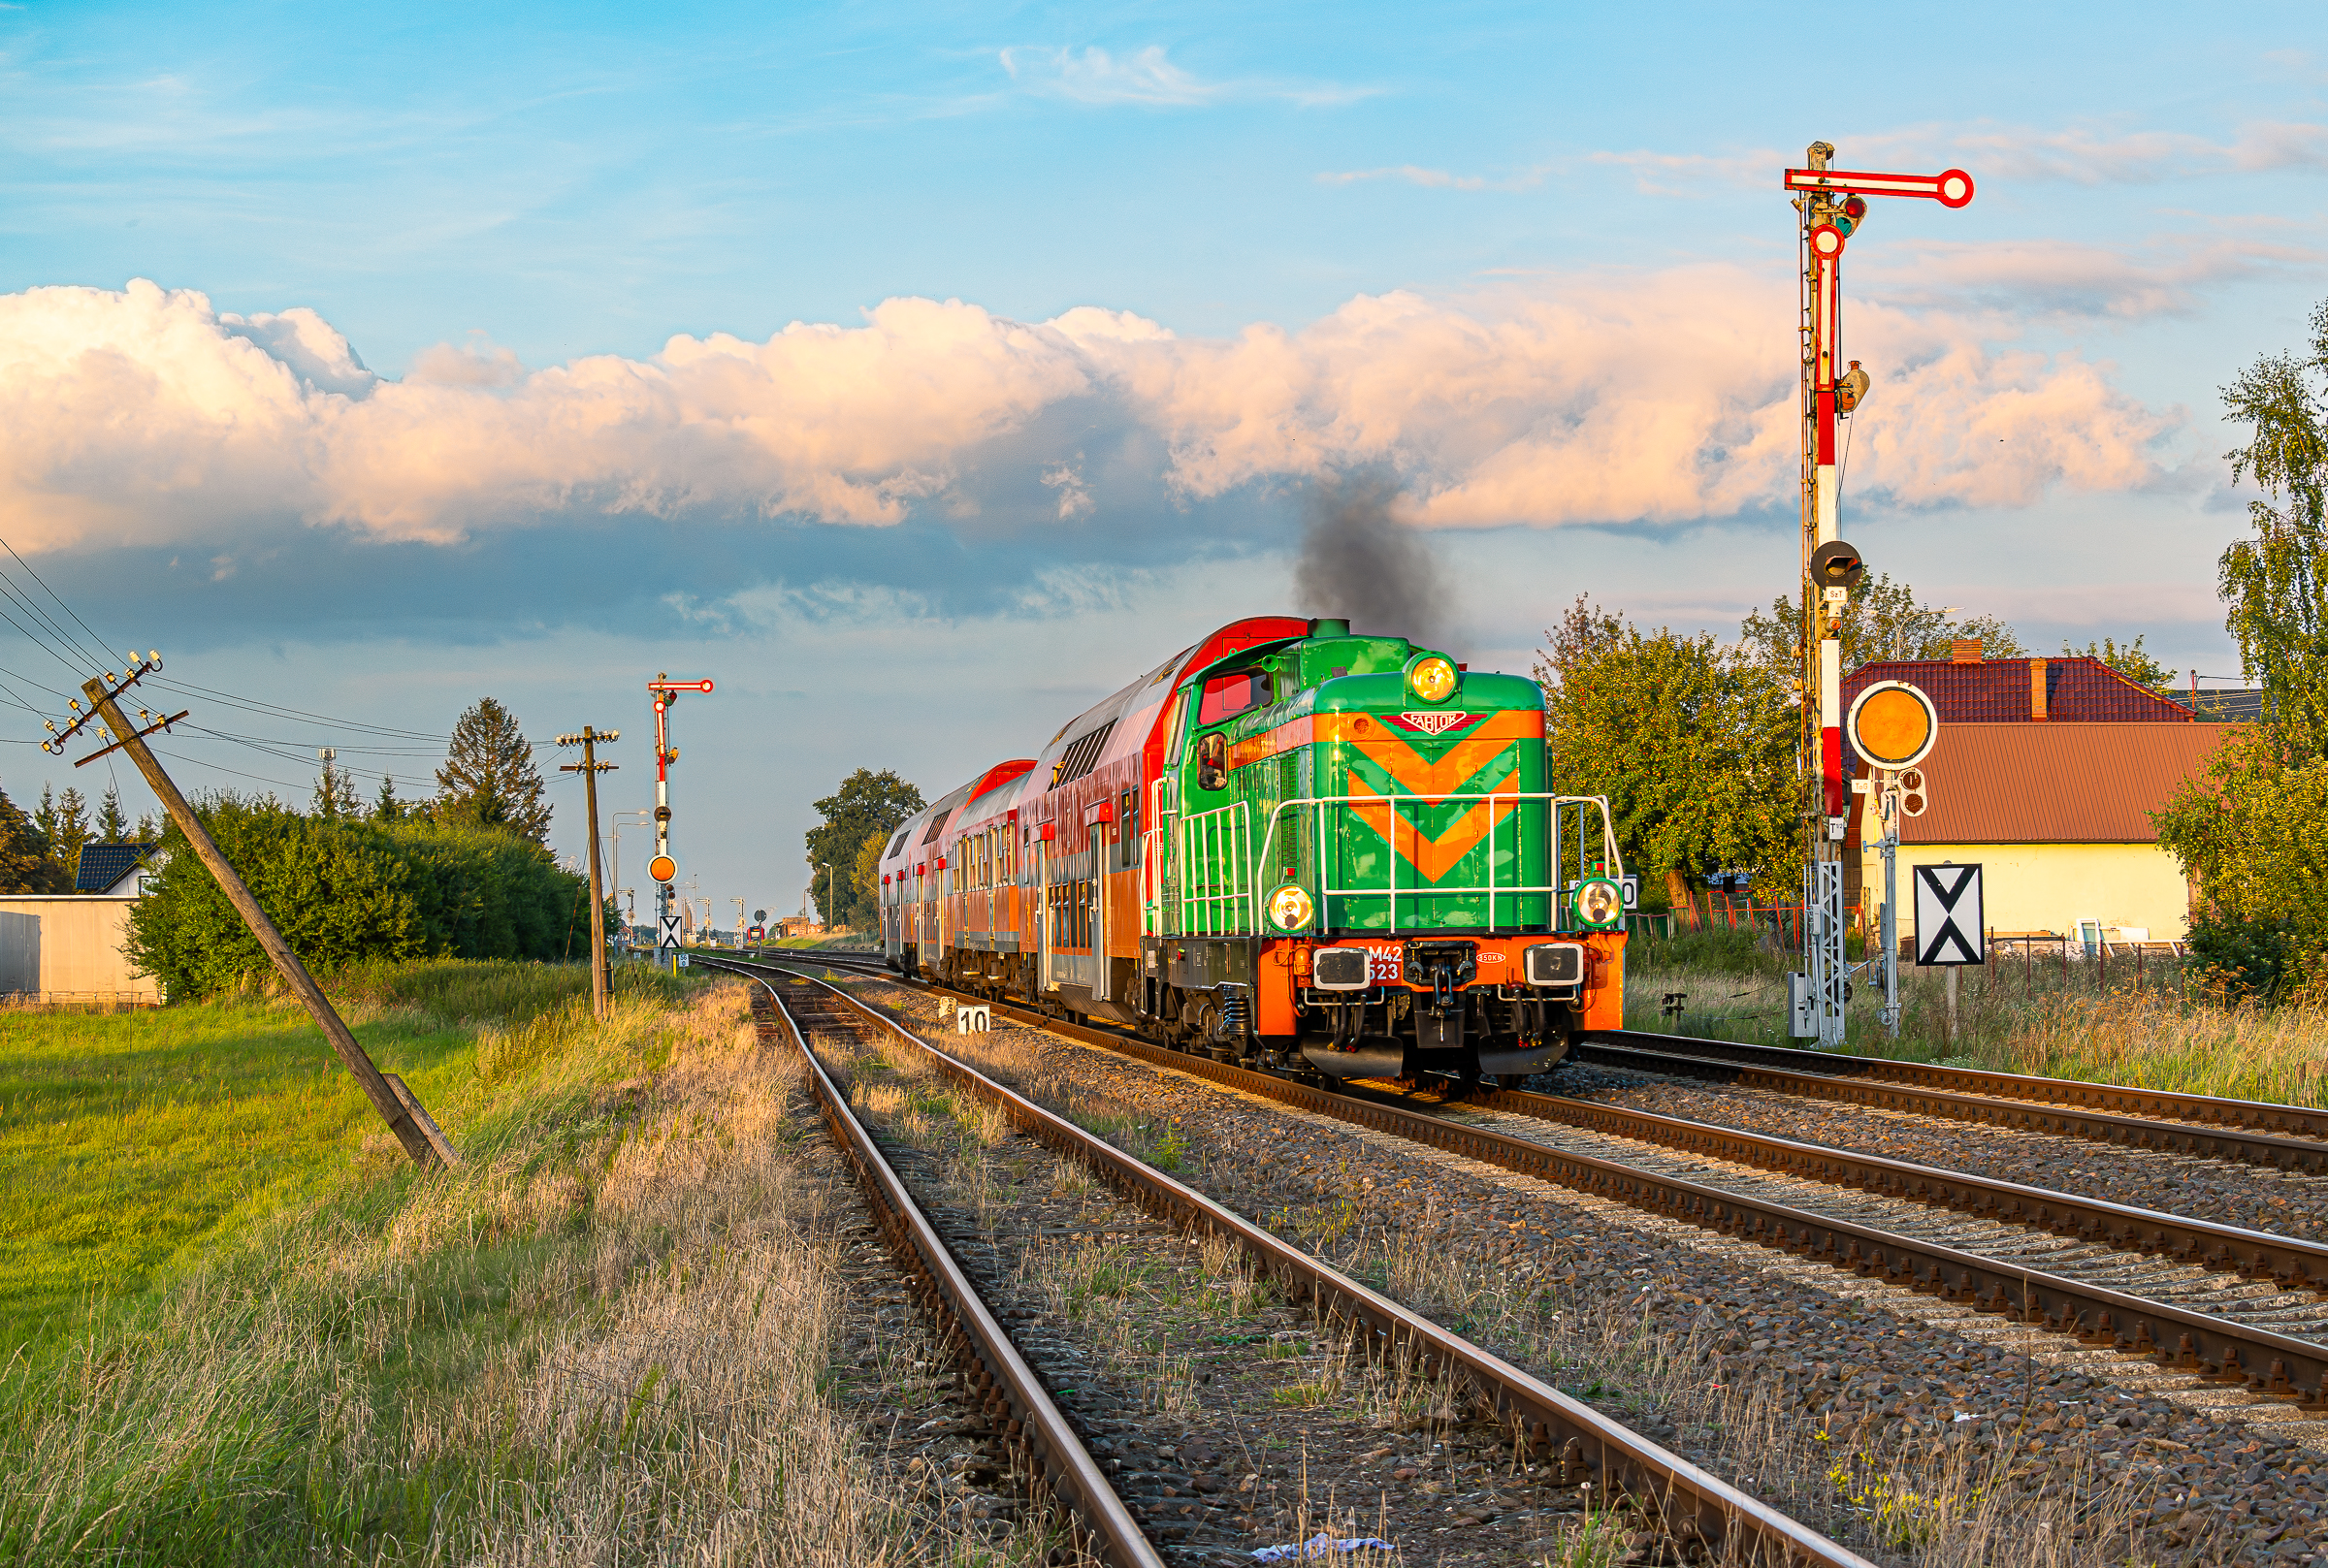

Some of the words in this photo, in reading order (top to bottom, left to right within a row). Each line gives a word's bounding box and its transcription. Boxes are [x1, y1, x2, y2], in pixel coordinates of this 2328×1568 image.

[1410, 714, 1457, 733] FABLOK
[1358, 945, 1403, 962] M42
[960, 1010, 987, 1038] 10
